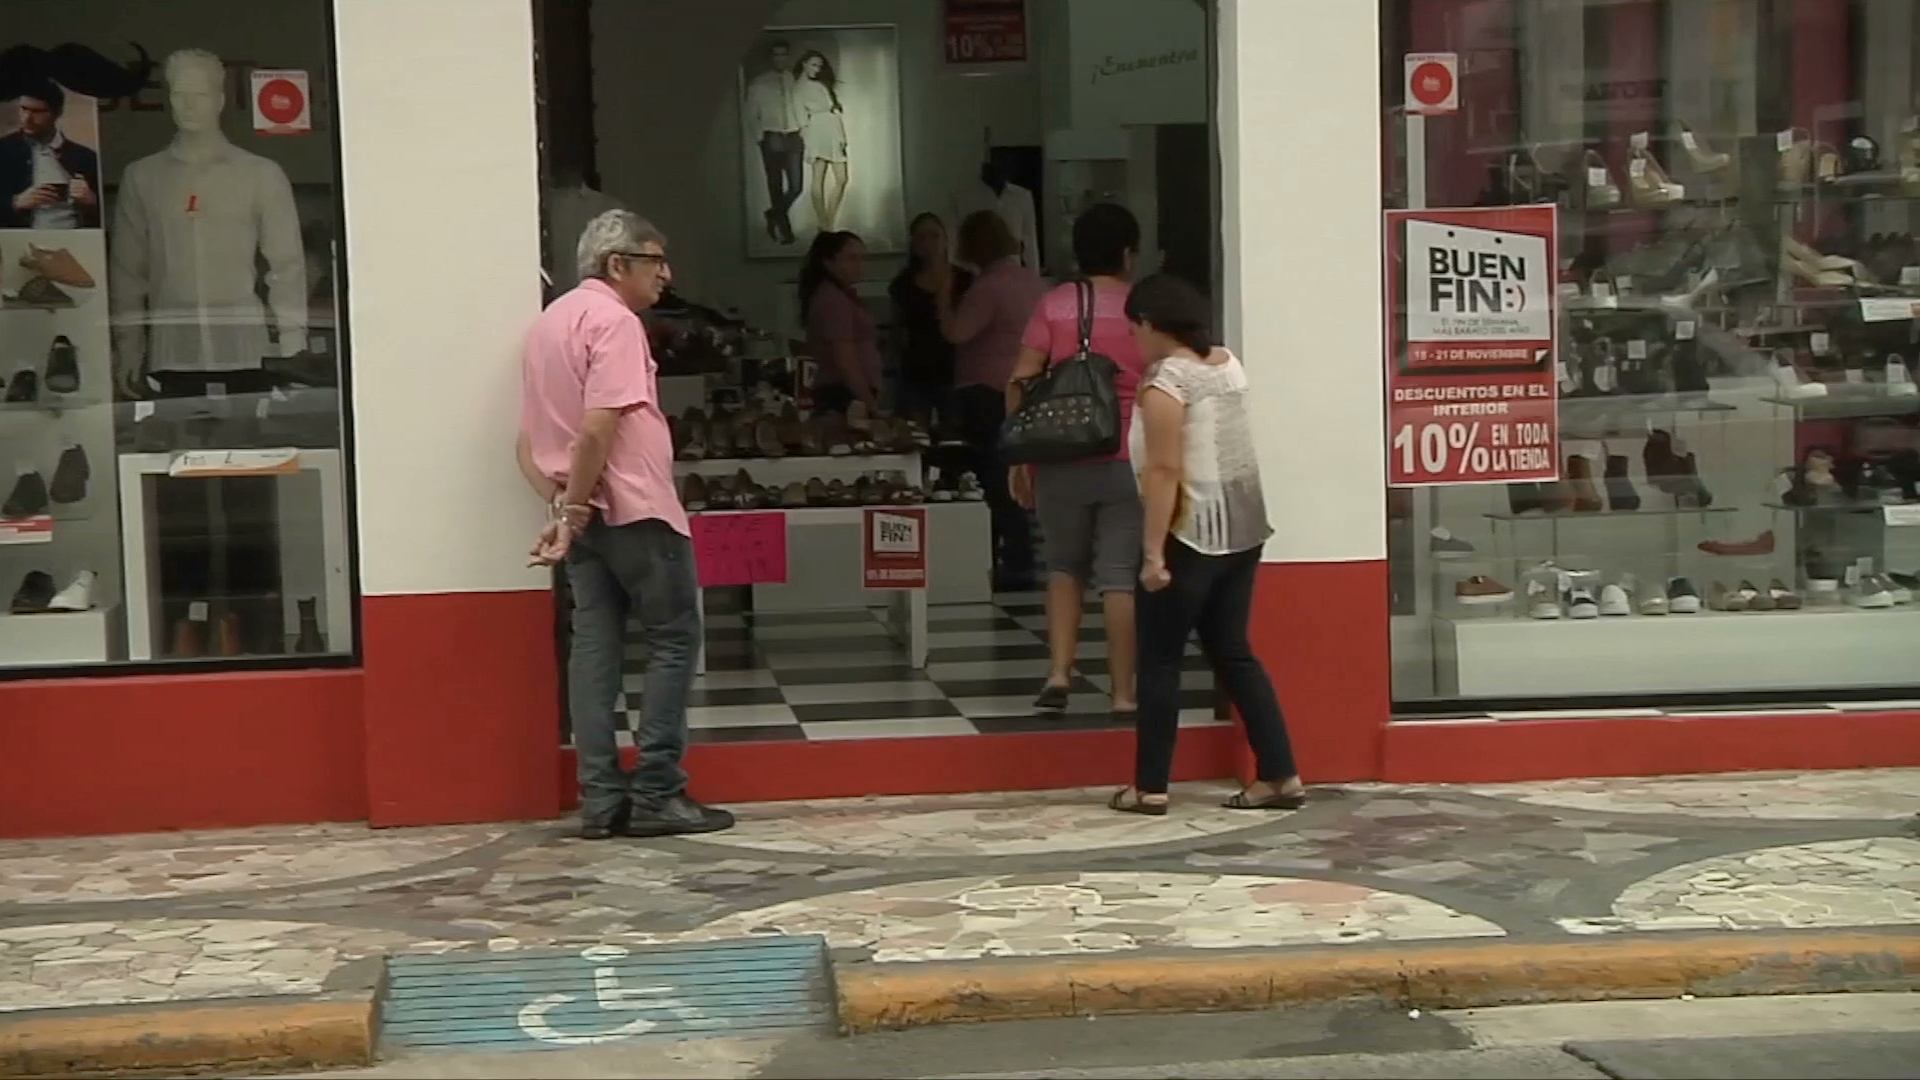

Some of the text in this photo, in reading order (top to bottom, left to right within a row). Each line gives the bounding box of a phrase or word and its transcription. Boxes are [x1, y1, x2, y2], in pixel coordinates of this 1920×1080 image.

[1429, 246, 1526, 281] BUEN
[1436, 349, 1448, 361] 21
[1450, 348, 1465, 360] DE
[1466, 348, 1528, 361] NOVIEMBRE
[1394, 383, 1549, 401] DESCUENTOS EN EL
[1433, 402, 1509, 417] INTERIOR
[1491, 422, 1549, 446] EN TODA
[1394, 421, 1490, 474] 10%
[1492, 448, 1550, 471] LA TIENDA
